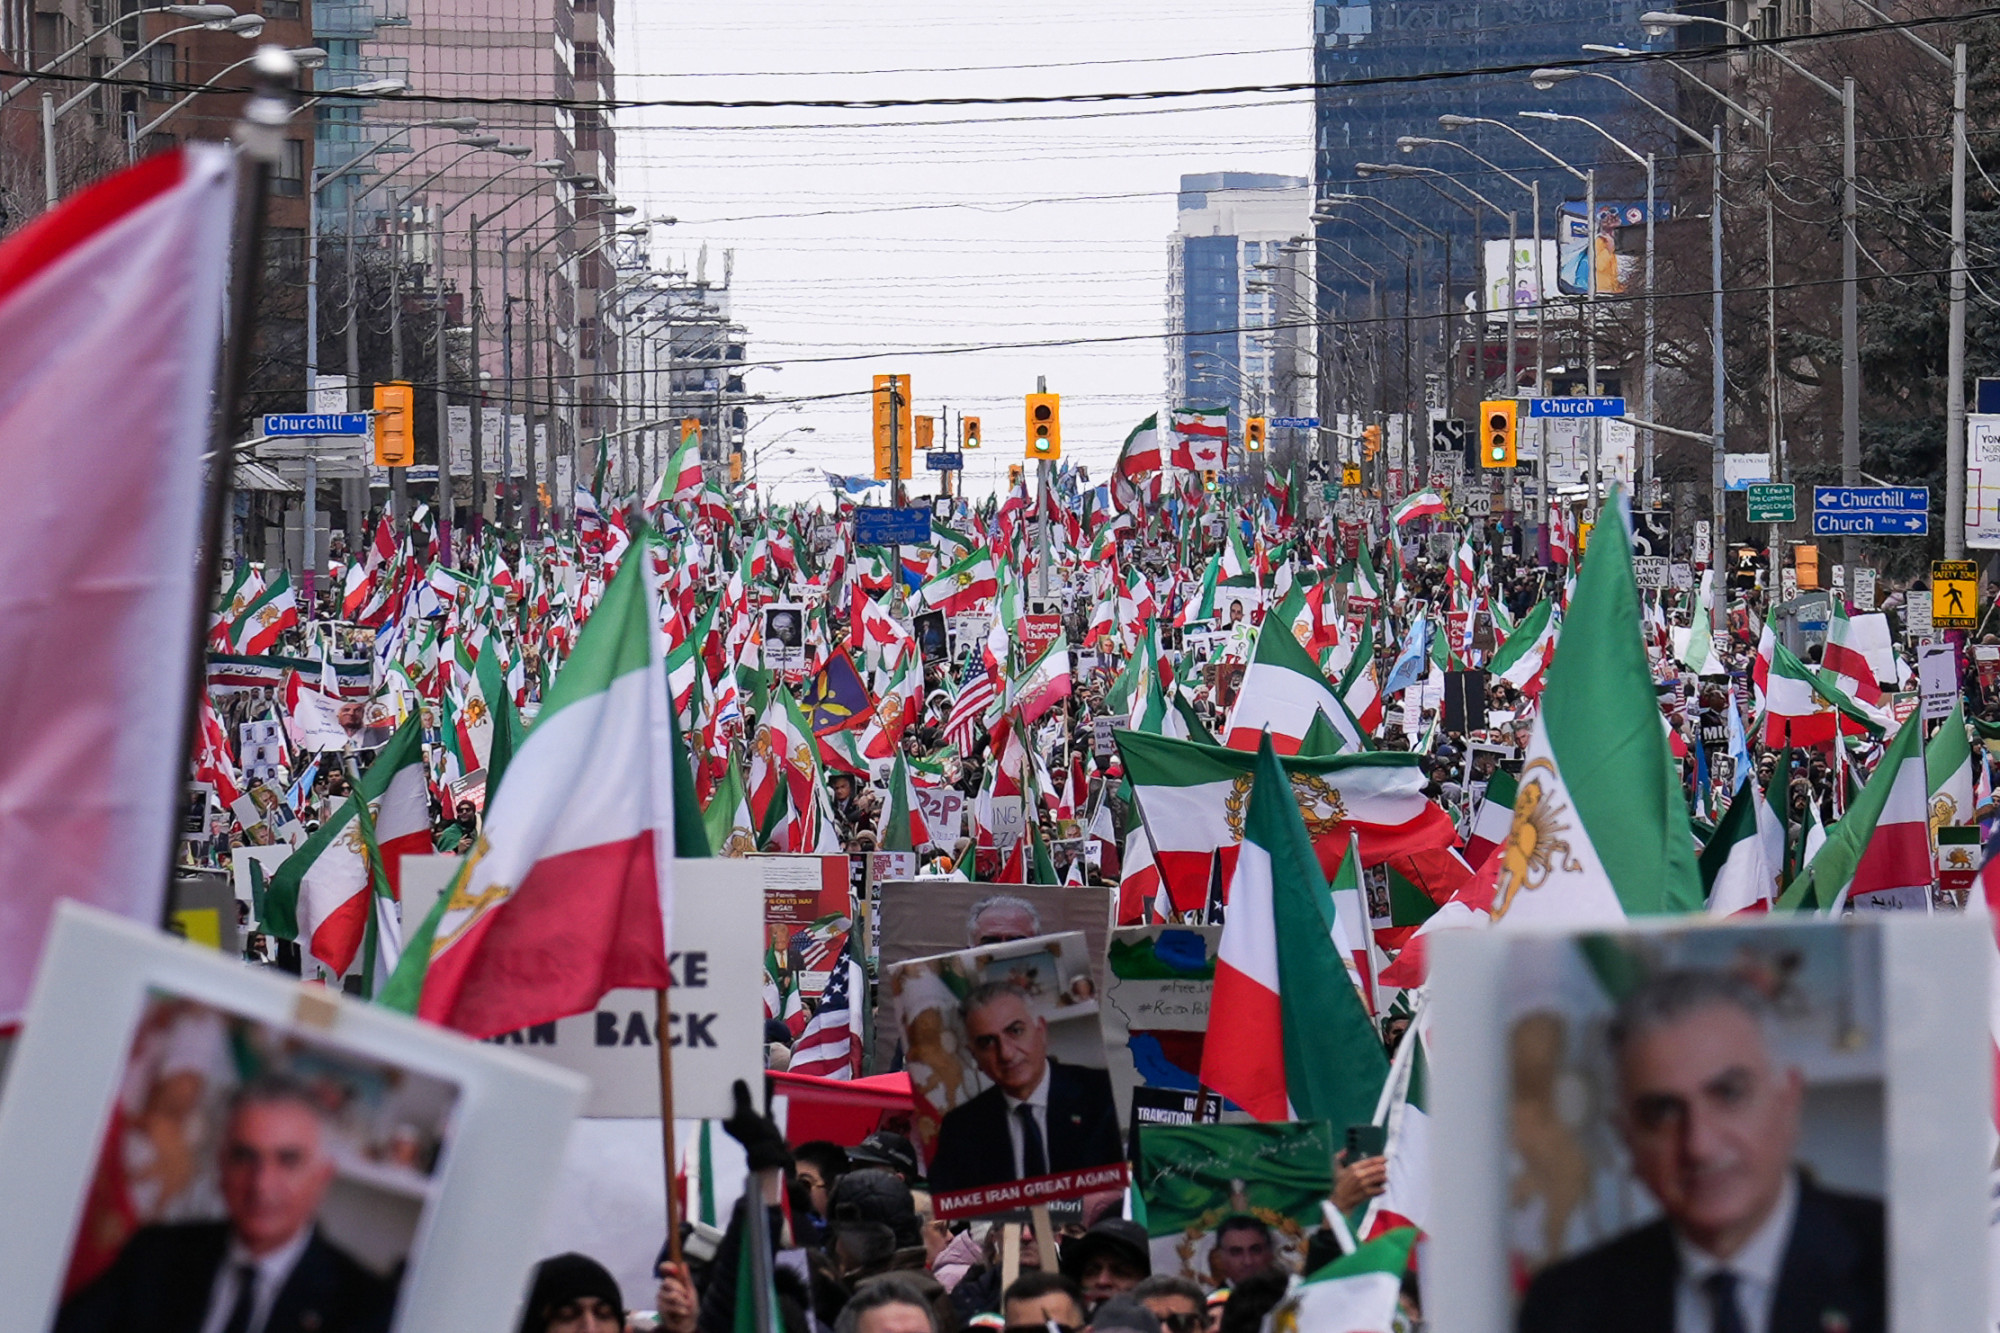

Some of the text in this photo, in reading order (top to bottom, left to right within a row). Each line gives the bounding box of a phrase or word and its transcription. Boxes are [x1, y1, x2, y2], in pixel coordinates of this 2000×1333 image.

[1541, 400, 1594, 414] Church
[268, 415, 343, 431] Churchill
[1981, 434, 2000, 444] YON
[1981, 445, 2000, 454] NOR
[1983, 455, 2000, 464] YOR
[1469, 499, 1489, 512] 40
[1840, 491, 1925, 507] Churchill Ave
[860, 511, 893, 521] Church
[1818, 515, 1897, 531] Church Ave
[1635, 576, 1660, 584] ONLY
[1933, 570, 1957, 579] SAFETY
[1025, 622, 1058, 633] Regime
[1450, 620, 1466, 629] Reg
[1026, 631, 1058, 642] Change
[916, 790, 962, 827] R2P
[992, 806, 1018, 825] ING
[992, 832, 1018, 848] EZA
[669, 953, 707, 987] KE
[595, 1012, 716, 1047] BACK
[1137, 1107, 1194, 1126] TRANSITION
[939, 1169, 1121, 1212] MAKE IRAN GREAT AGAIN
